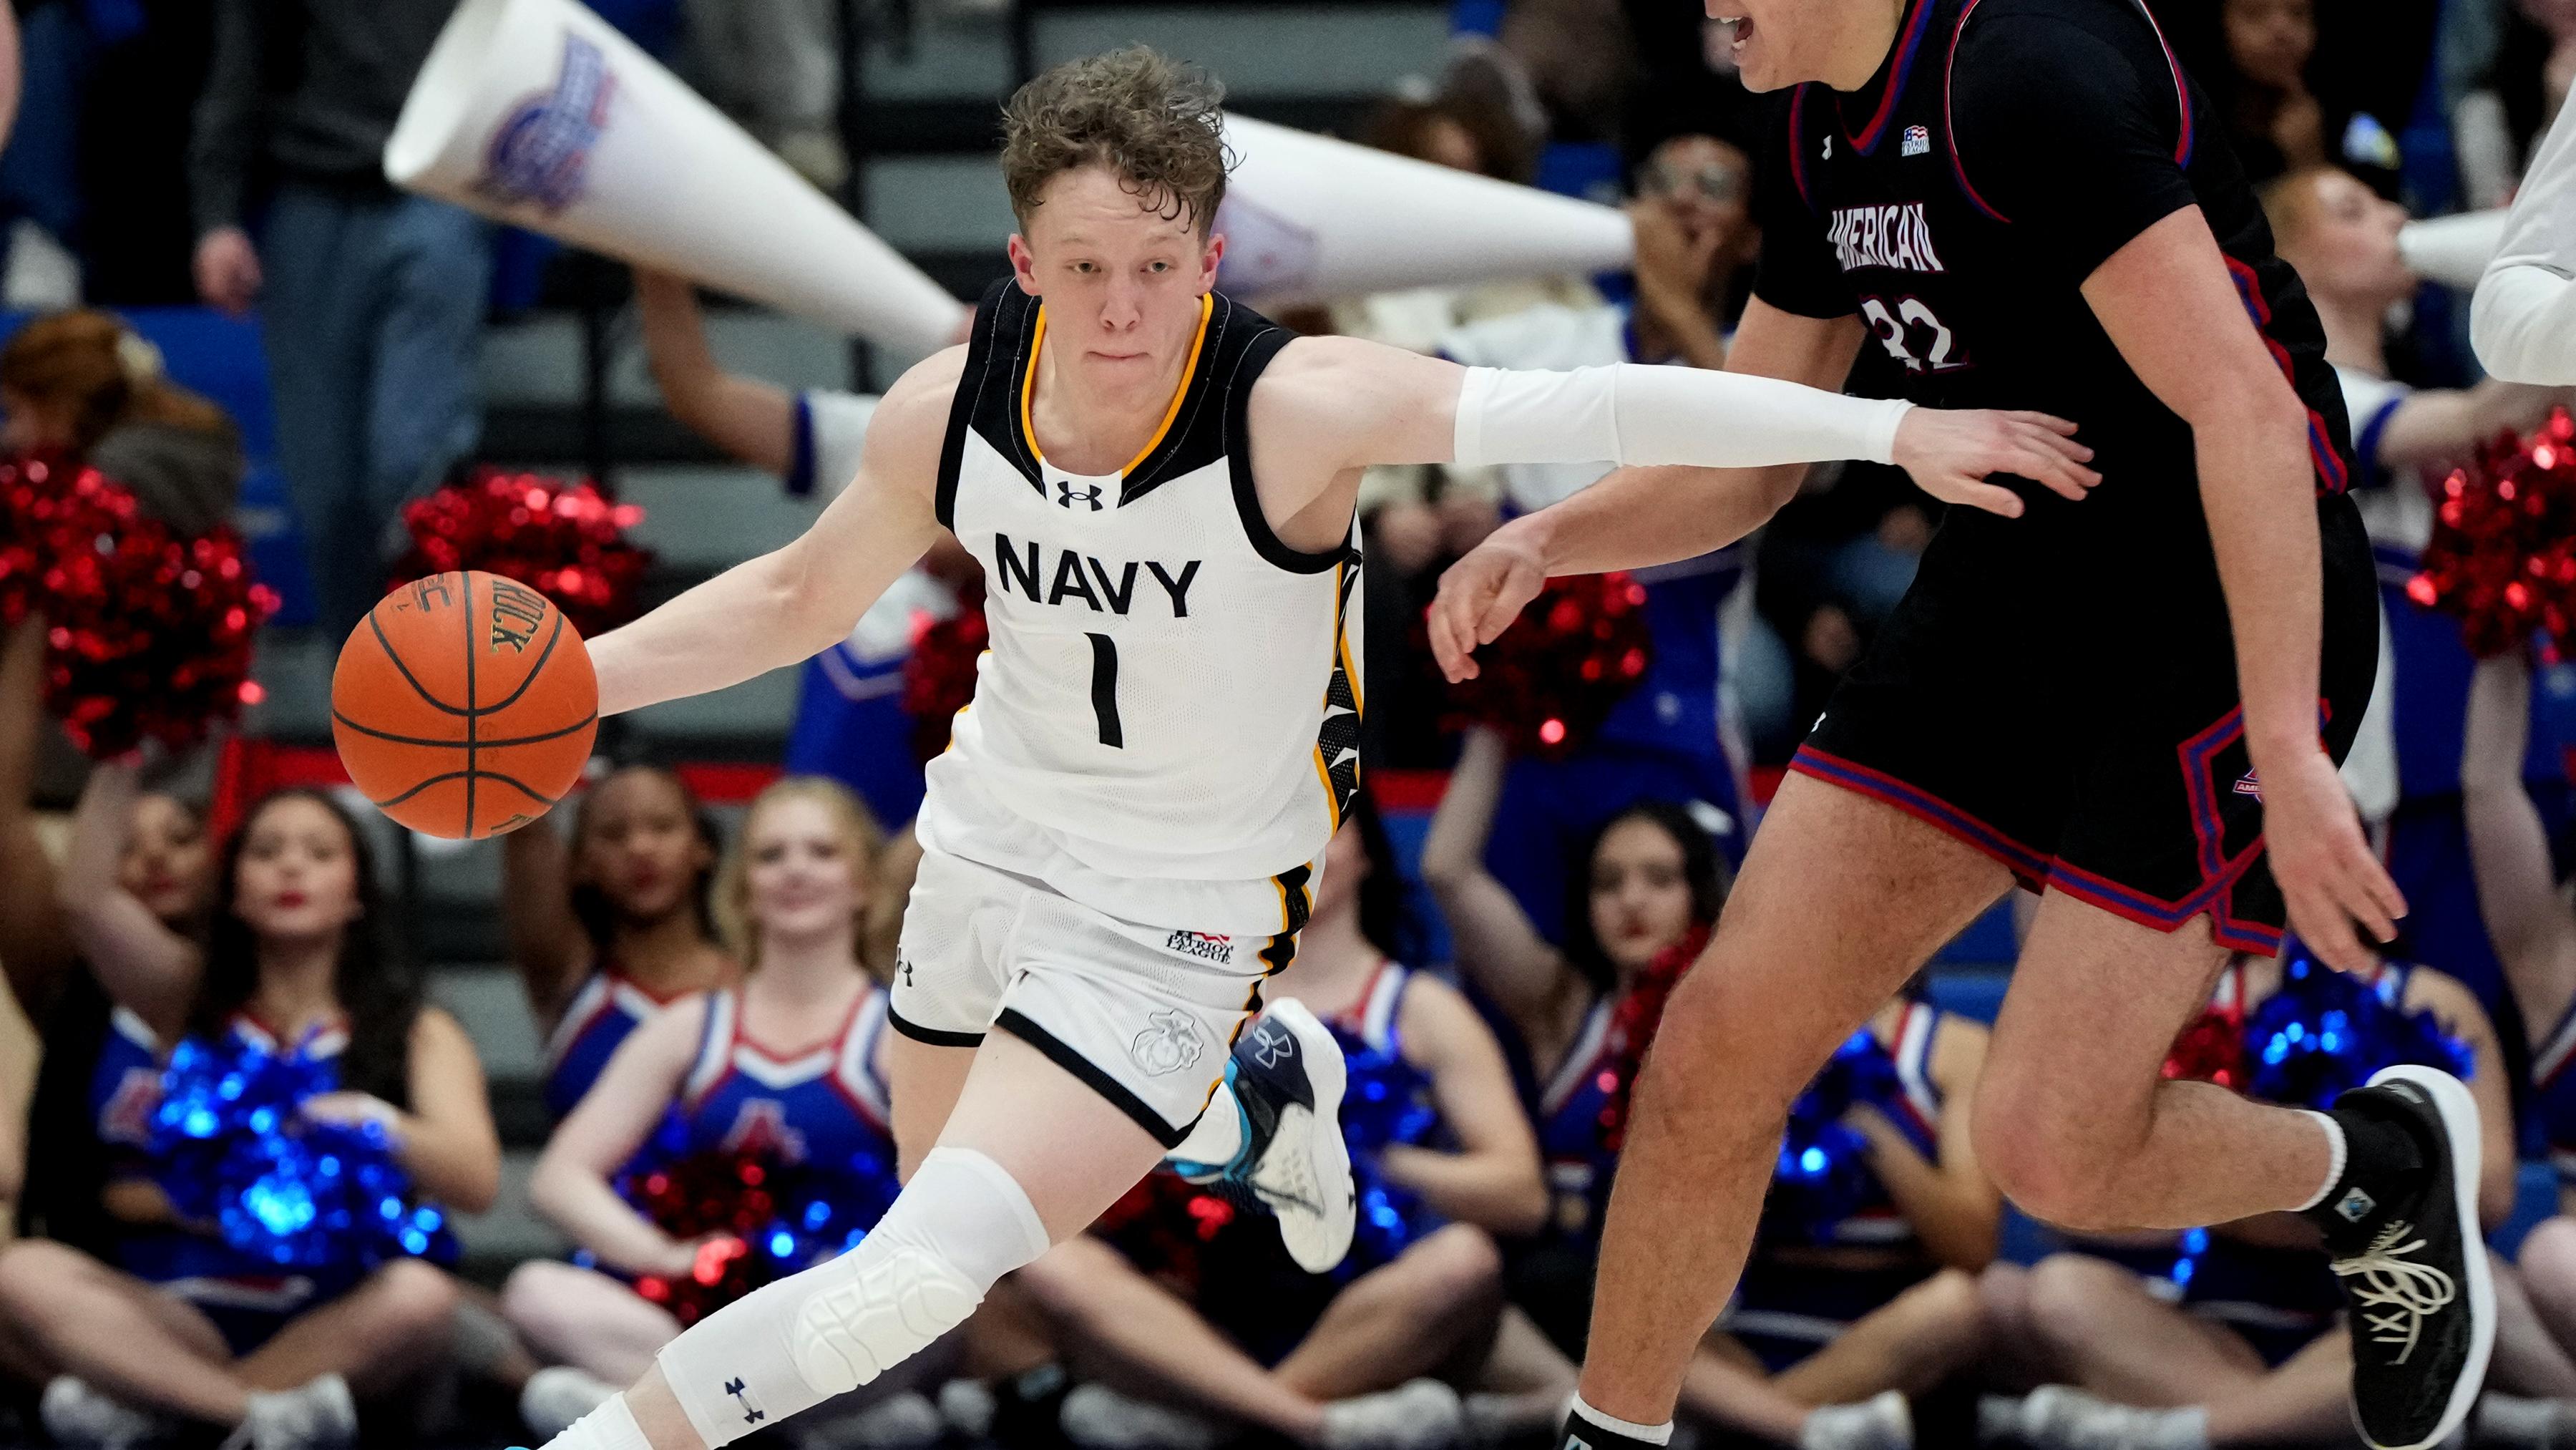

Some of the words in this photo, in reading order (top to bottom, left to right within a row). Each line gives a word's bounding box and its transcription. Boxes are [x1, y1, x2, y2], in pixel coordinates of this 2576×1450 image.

[1861, 298, 1967, 371] 32
[995, 532, 1201, 618] NAVY
[491, 580, 547, 653] ROCK
[1083, 632, 1123, 749] 1
[1166, 939, 1231, 964] LEAGUE
[1168, 933, 1234, 955] PATRIOT
